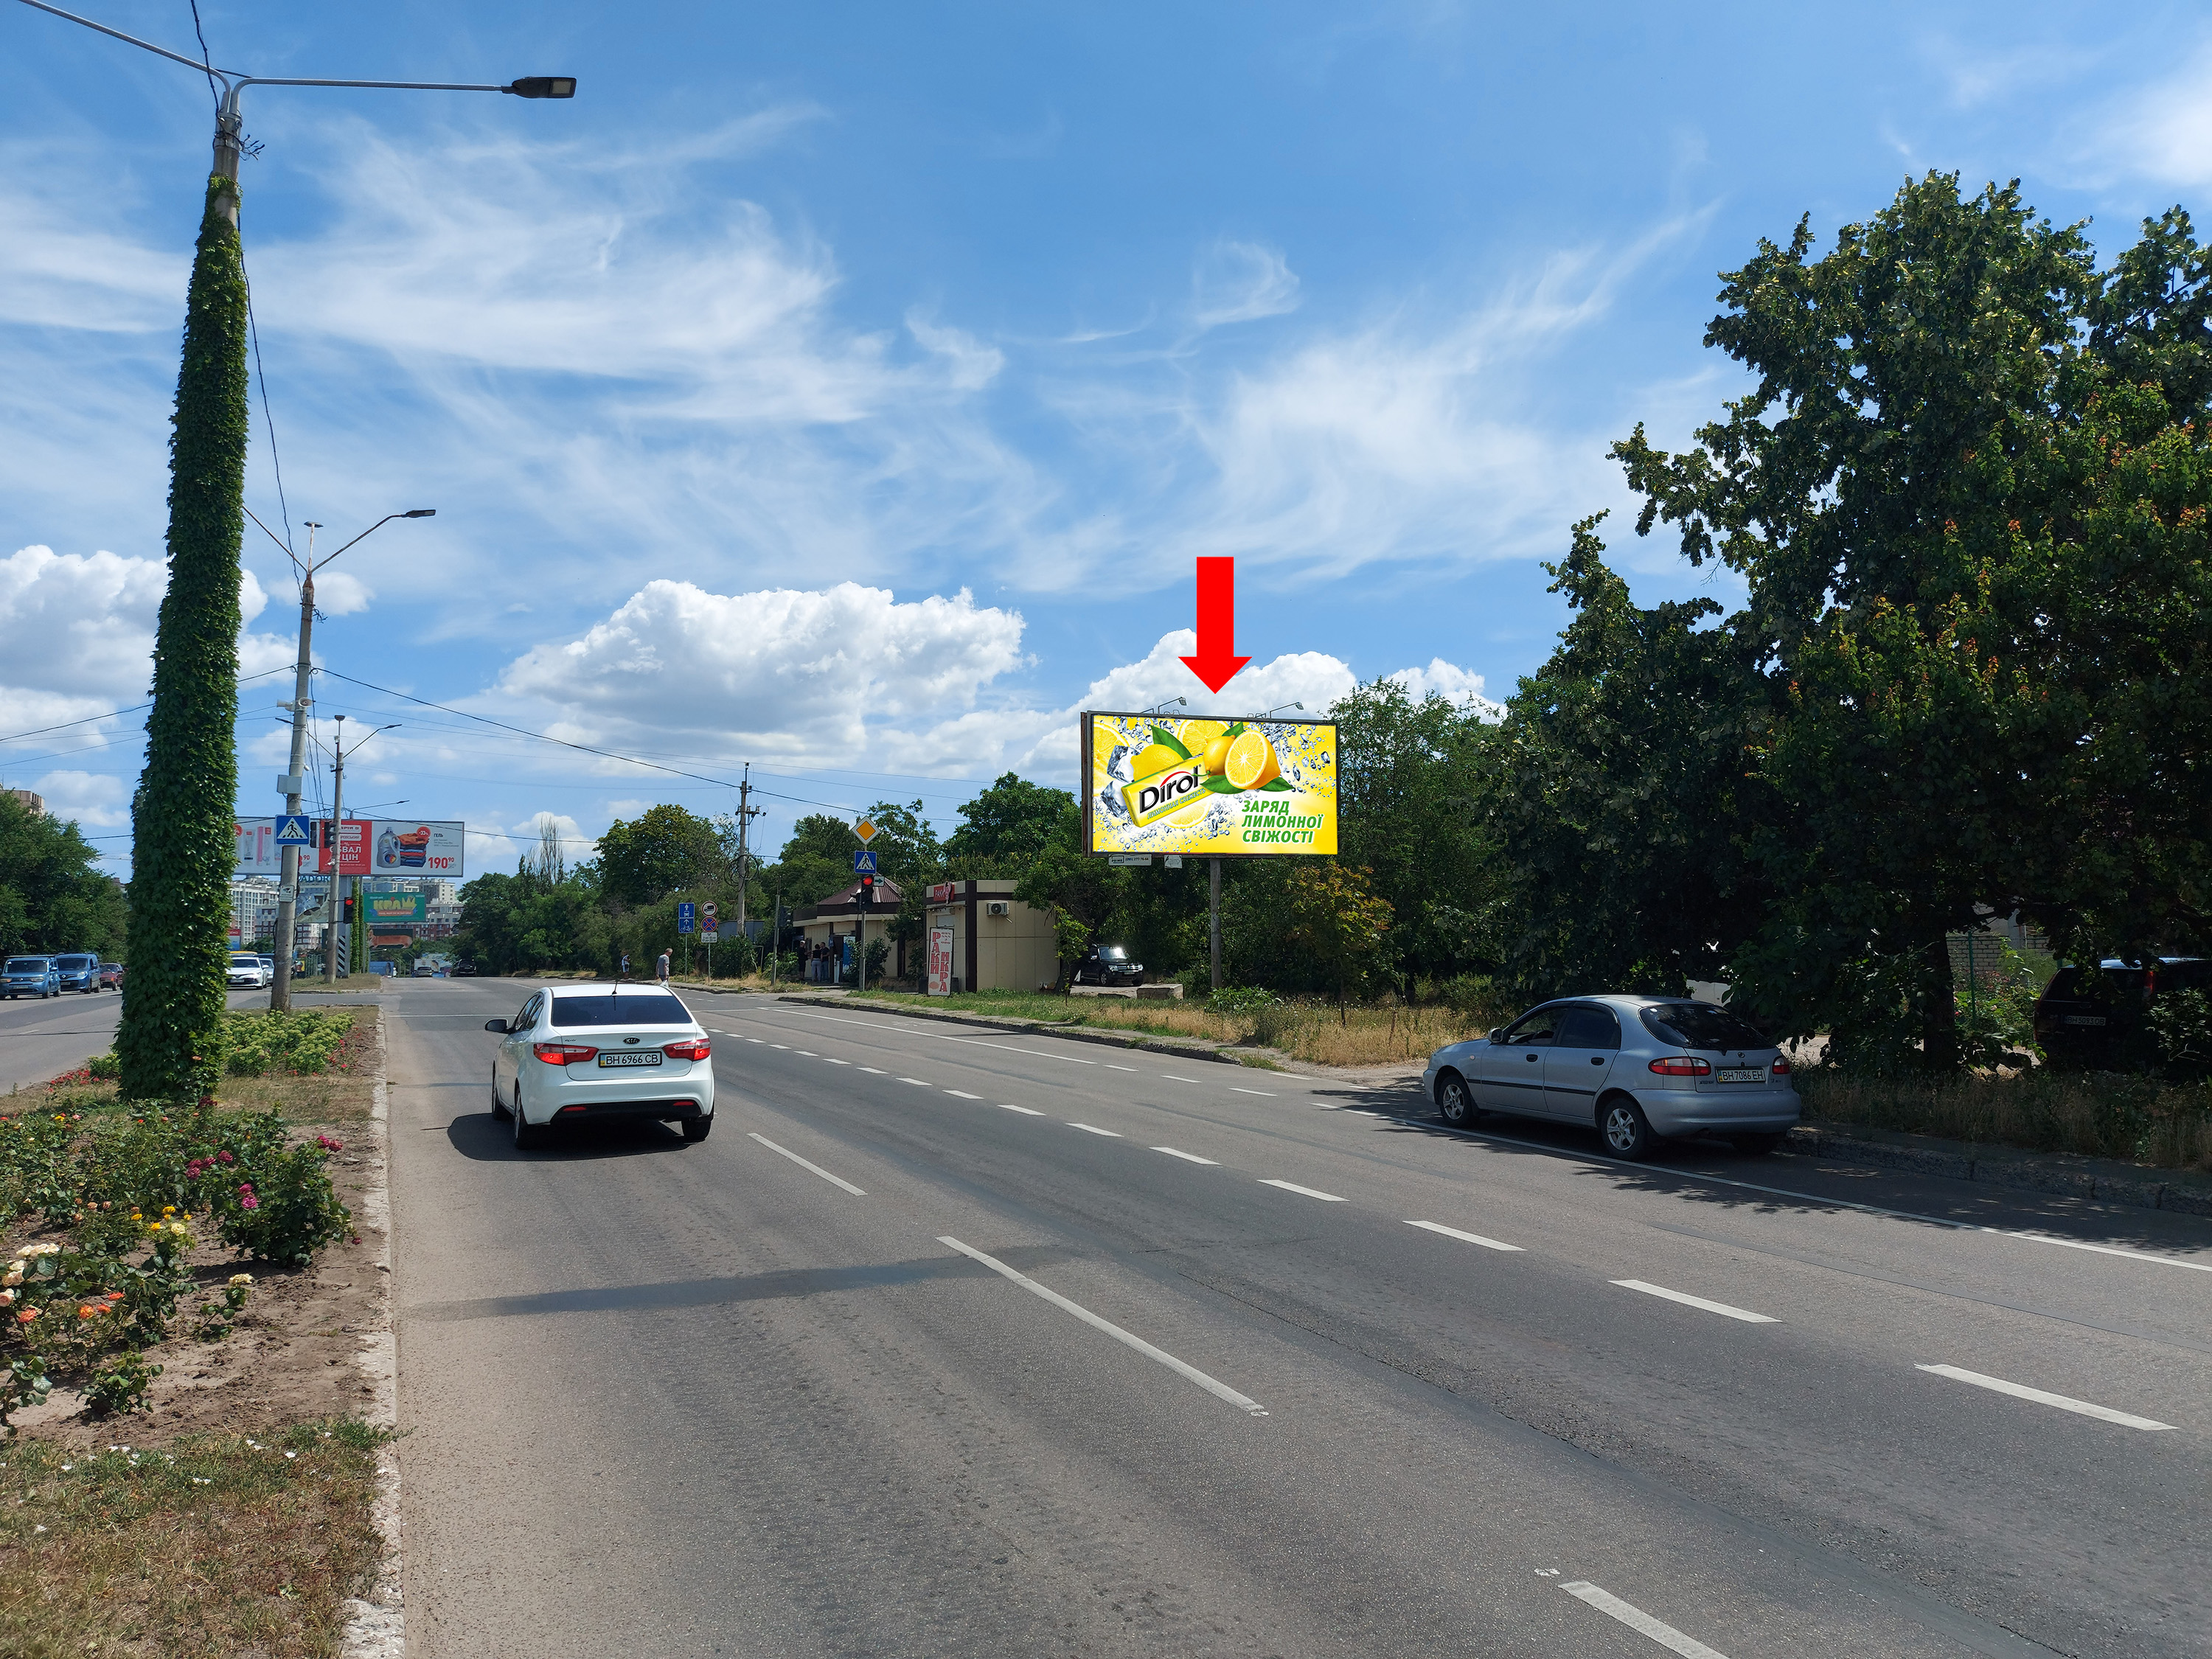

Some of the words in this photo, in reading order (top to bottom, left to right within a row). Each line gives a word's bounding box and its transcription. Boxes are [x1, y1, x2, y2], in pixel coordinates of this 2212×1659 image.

[1139, 765, 1198, 813] Dirol
[1147, 799, 1179, 819] ЛИМОННАЯ
[1178, 787, 1206, 804] СВЕЖЕСТЬ
[1242, 800, 1290, 815] ЗАРЯД
[1242, 813, 1324, 828] ЛИМОННОЇ
[1242, 830, 1313, 844] СВІЖОСТІ
[428, 857, 448, 869] 190
[931, 932, 942, 974] РАКИ
[939, 951, 950, 992] ИКРА
[606, 1056, 620, 1065] BH
[622, 1054, 643, 1064] 6966
[644, 1054, 658, 1063] CB
[1722, 1071, 1734, 1080] BH
[1734, 1071, 1751, 1080] 7086
[1753, 1071, 1764, 1079] EH
